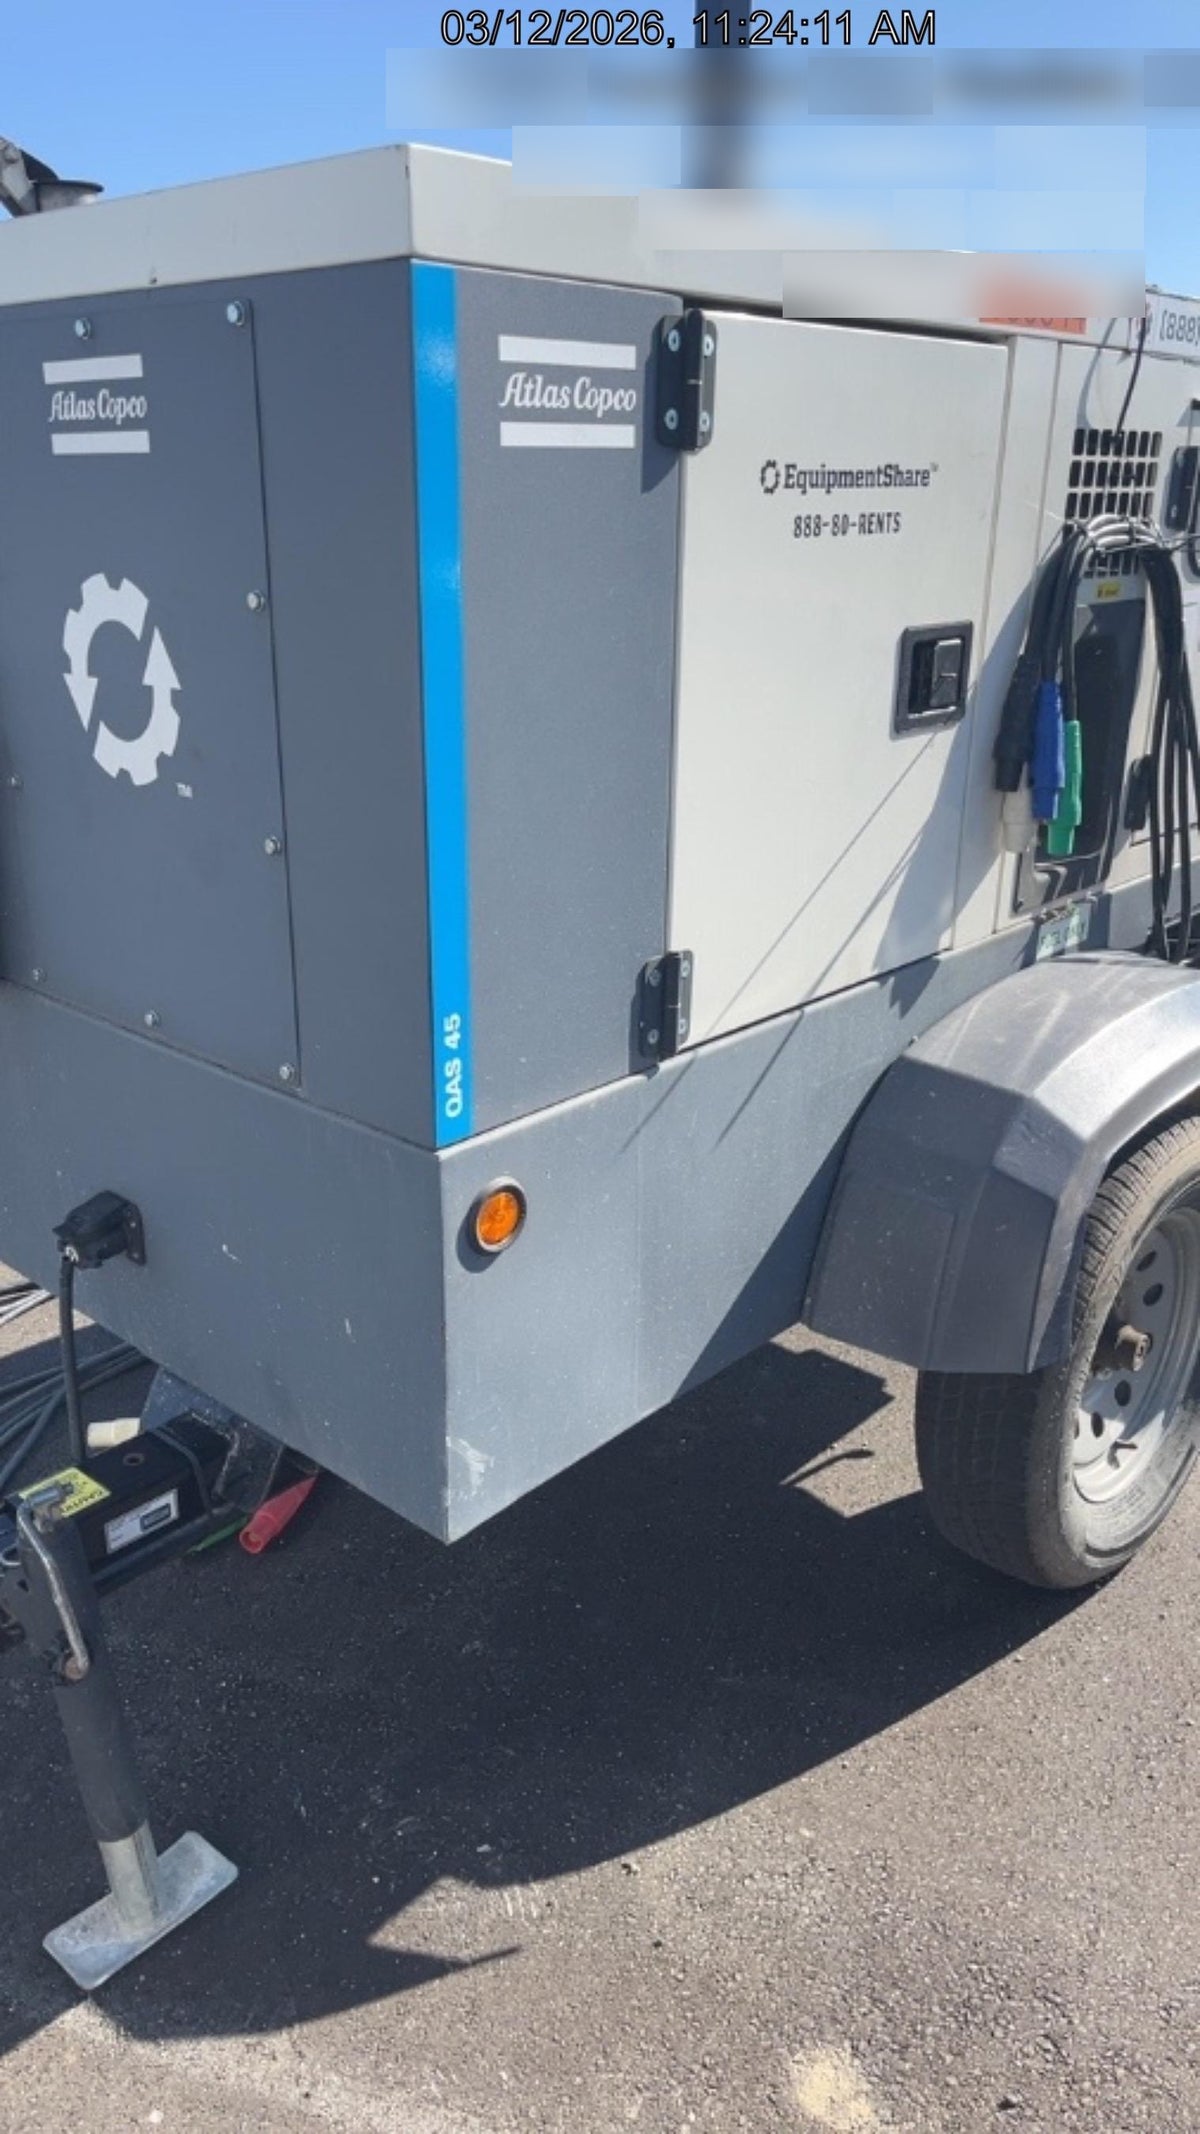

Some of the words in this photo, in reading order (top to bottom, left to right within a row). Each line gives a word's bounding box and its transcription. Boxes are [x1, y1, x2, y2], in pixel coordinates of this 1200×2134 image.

[48, 391, 96, 423] Atlas
[97, 388, 148, 425] Copco
[499, 372, 571, 408] Atlas
[573, 376, 636, 418] Copco
[784, 464, 930, 495] EquipmentShare
[793, 512, 902, 538] 888-80-RENTS
[443, 1013, 461, 1049] 45
[443, 1057, 463, 1118] QAS
